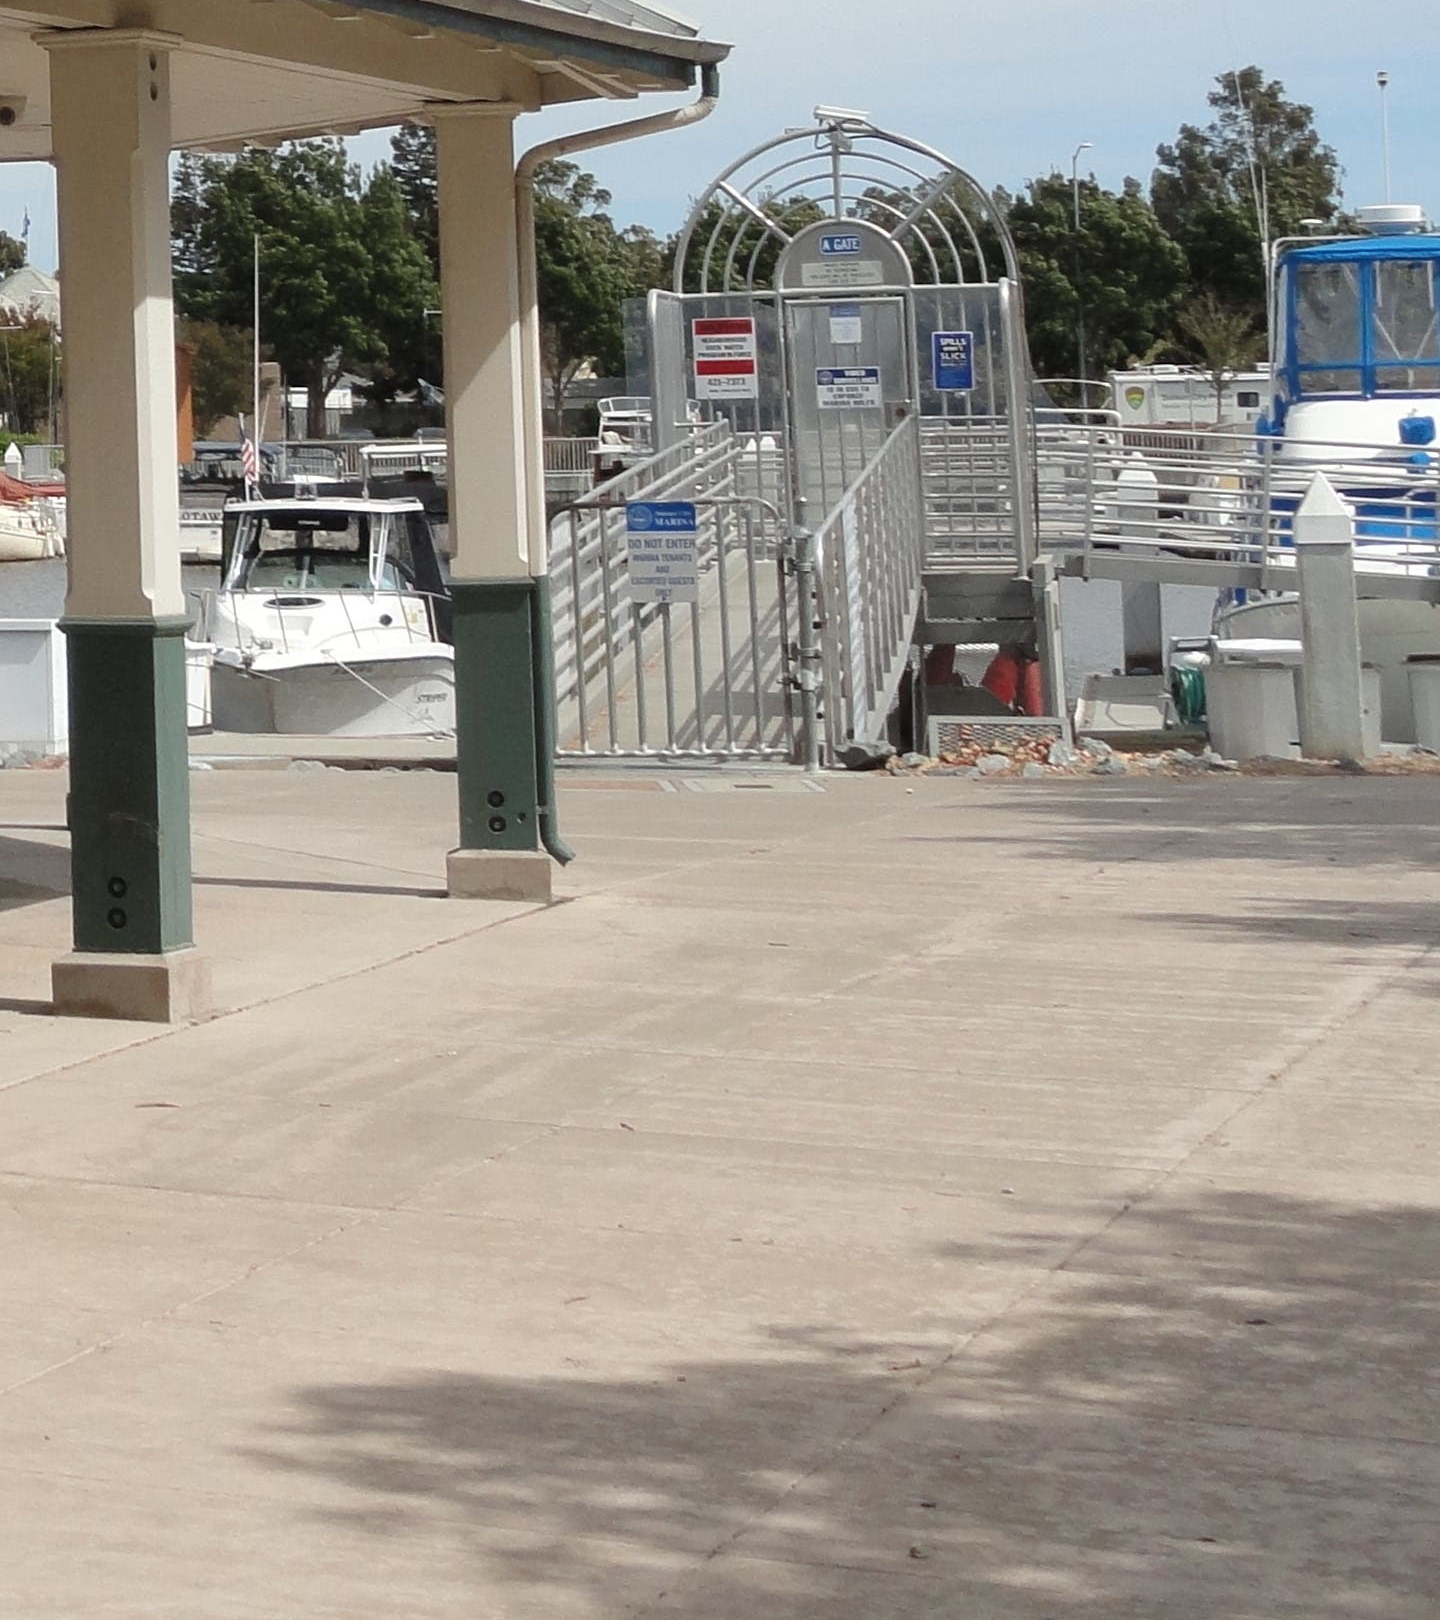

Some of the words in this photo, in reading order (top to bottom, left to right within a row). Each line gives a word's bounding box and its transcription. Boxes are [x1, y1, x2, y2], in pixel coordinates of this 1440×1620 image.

[822, 239, 831, 251] A
[833, 237, 860, 251] GATE
[628, 538, 642, 549] DO
[644, 538, 662, 549] NOT
[665, 538, 696, 549] ENTER
